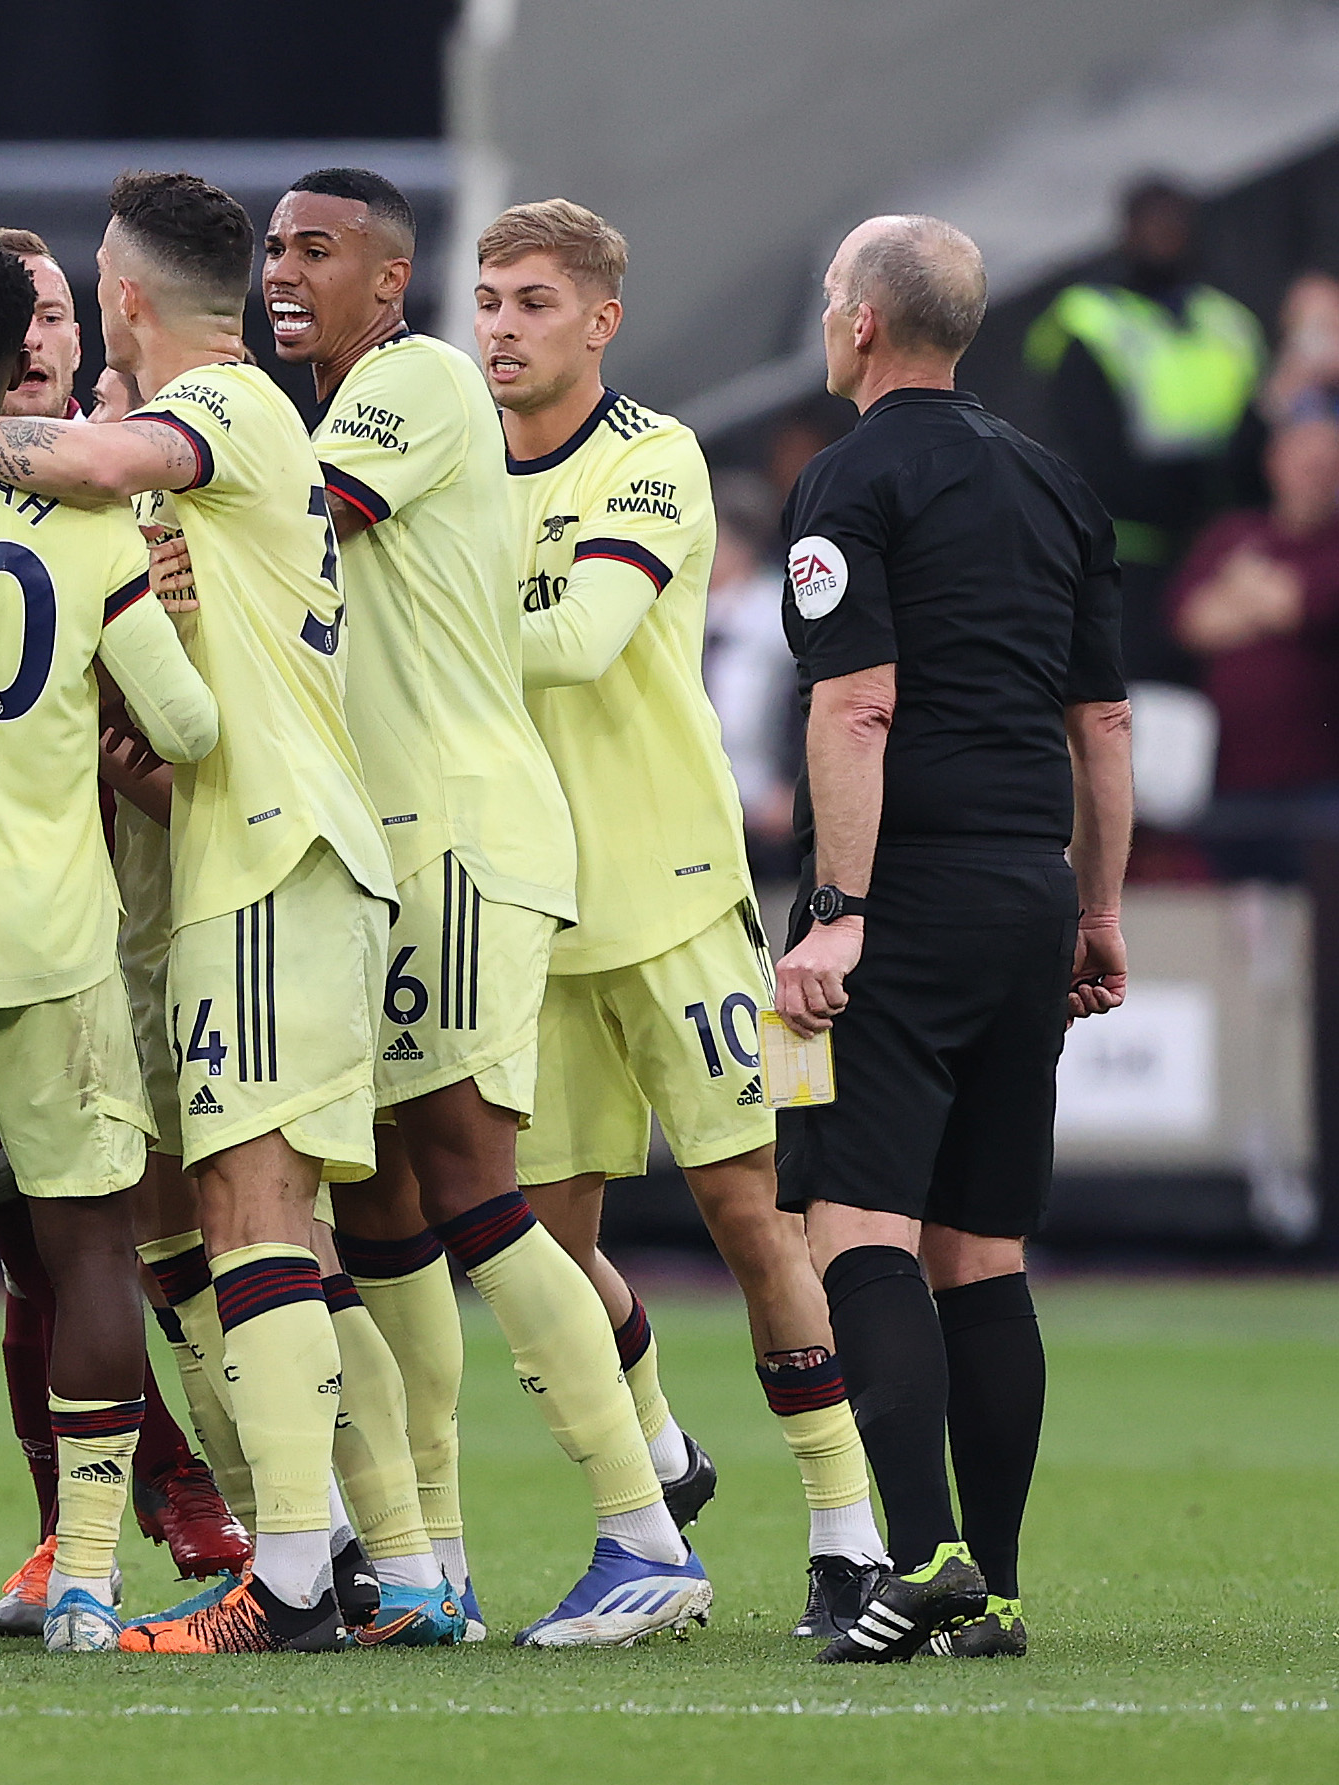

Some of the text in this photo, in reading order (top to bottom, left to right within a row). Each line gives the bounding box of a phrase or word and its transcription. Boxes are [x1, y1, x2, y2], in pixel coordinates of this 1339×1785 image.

[180, 384, 229, 404] VISIT
[155, 391, 232, 434] RWANDA
[356, 402, 405, 431] VISIT
[330, 418, 409, 454] RWANDA
[630, 479, 677, 500] VISIT
[792, 553, 833, 587] EA
[797, 575, 838, 603] PORTS
[383, 945, 429, 1026] 6
[684, 991, 760, 1079] 10
[382, 1049, 425, 1062] adidas
[188, 1104, 225, 1117] adidas
[70, 1470, 127, 1484] adidas
